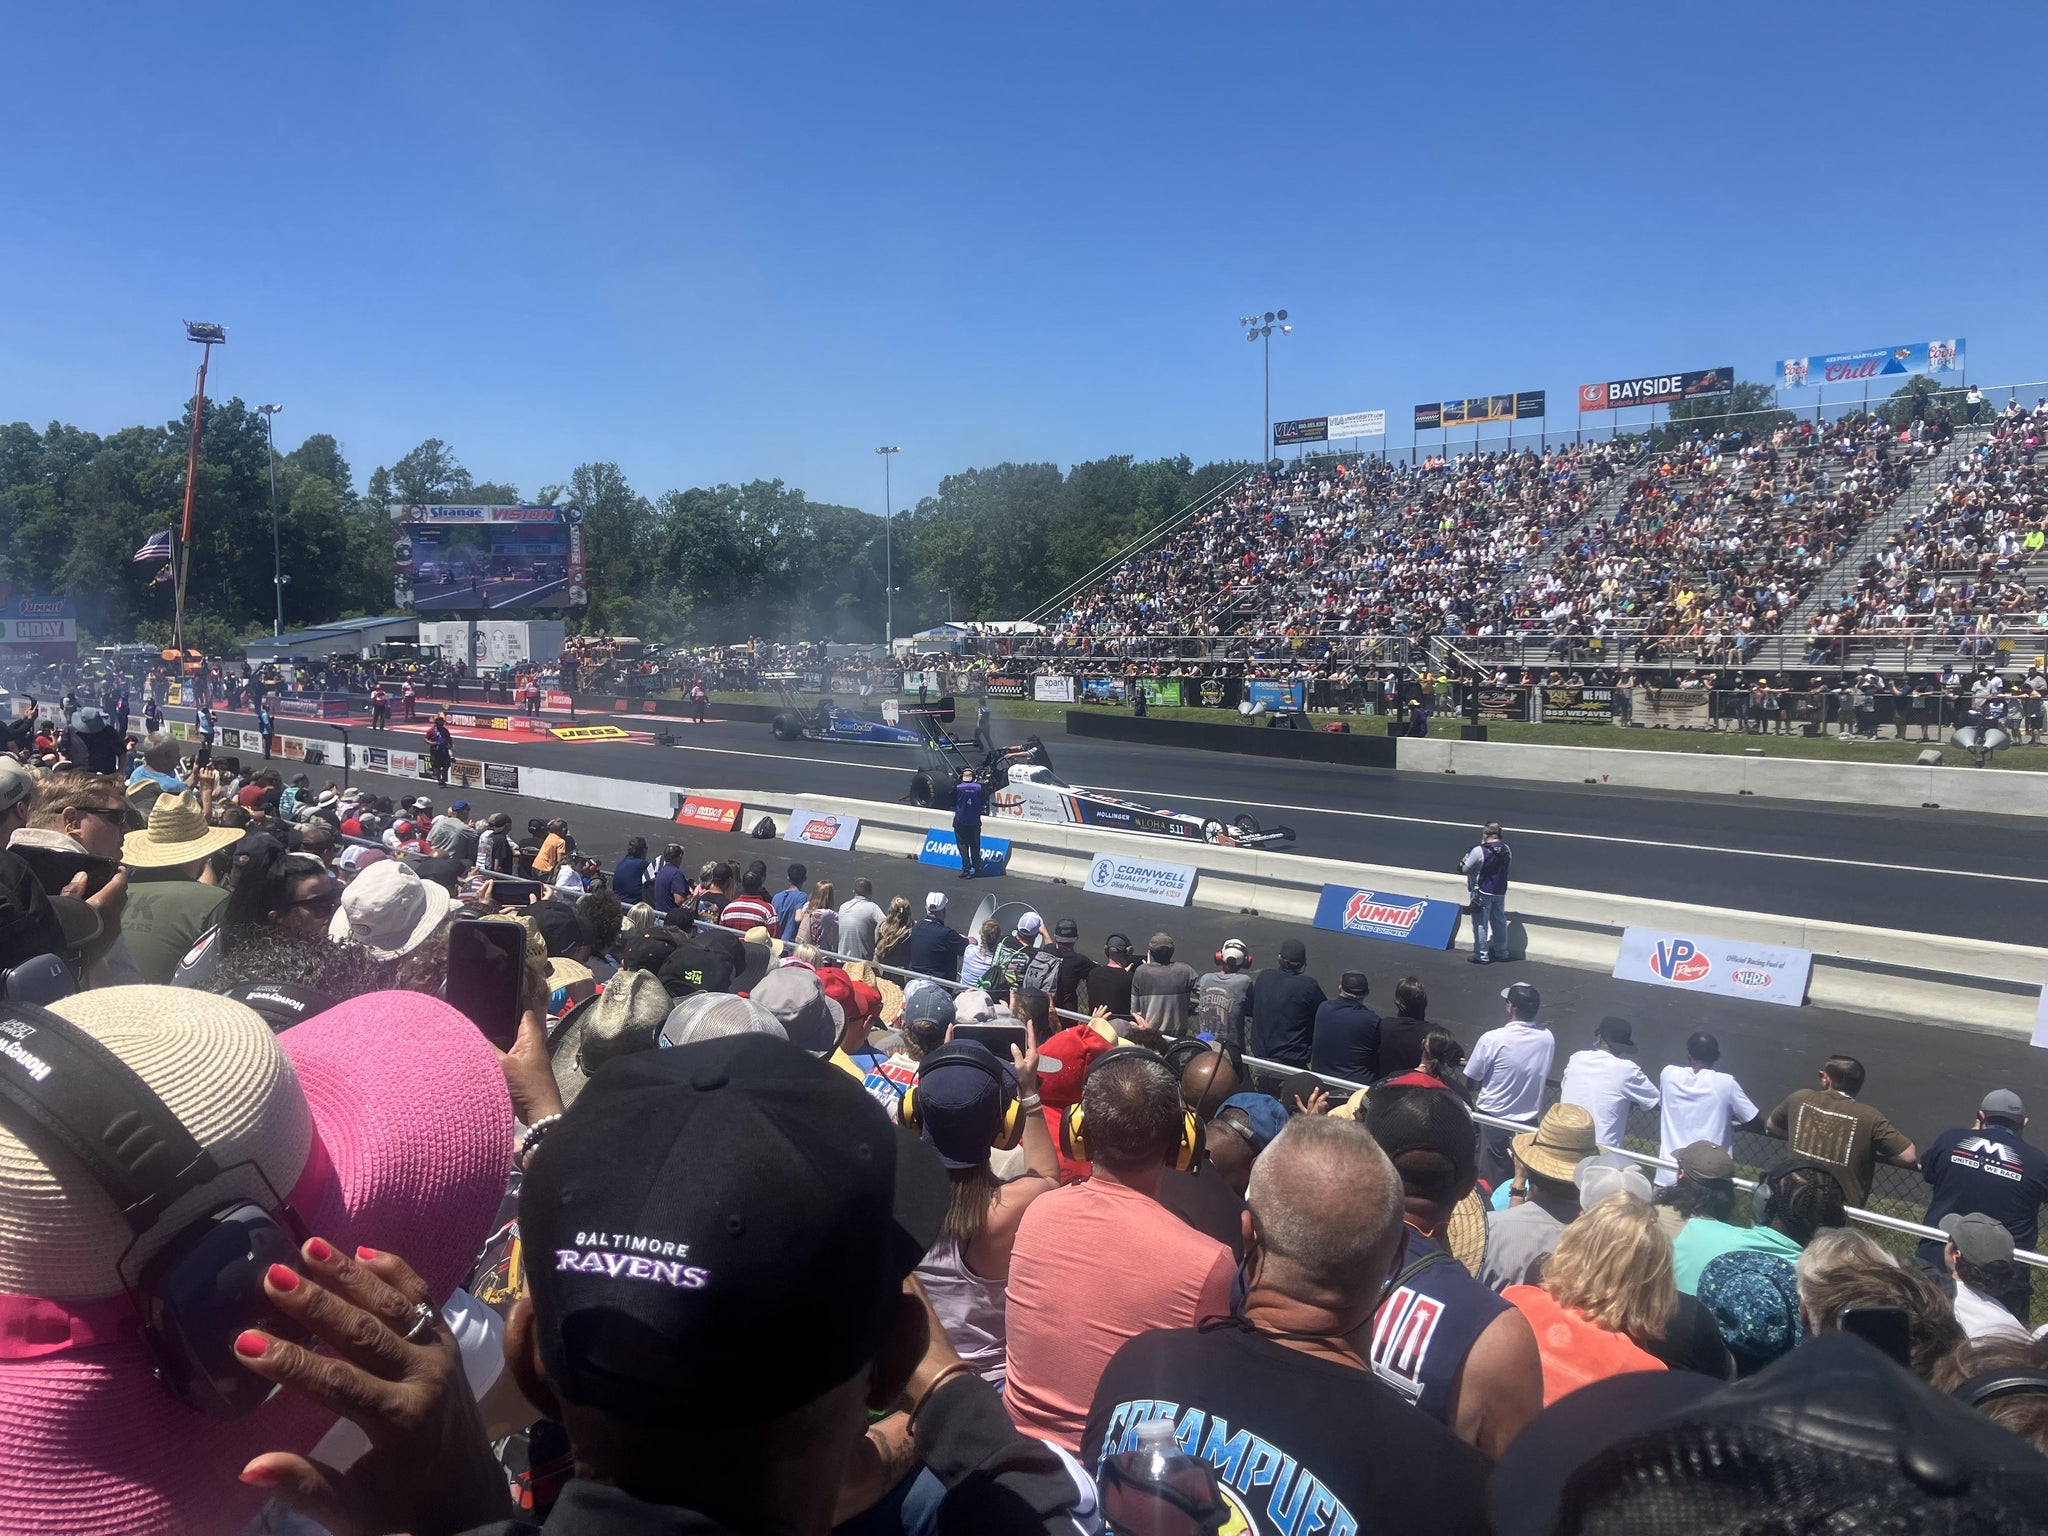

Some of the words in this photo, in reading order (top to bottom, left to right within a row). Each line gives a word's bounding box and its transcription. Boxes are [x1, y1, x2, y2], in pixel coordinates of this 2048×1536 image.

[1852, 351, 1887, 361] MARYLAND
[1825, 359, 1882, 382] Chill
[1609, 376, 1682, 400] BAYSIDE
[1274, 421, 1299, 437] VIA
[430, 506, 484, 518] Strange
[491, 507, 556, 521] VISION
[1044, 679, 1064, 689] spark
[1582, 690, 1594, 700] WE
[1594, 690, 1612, 700] PAVE
[560, 728, 619, 737] JEGS
[452, 764, 480, 777] FARMER
[966, 798, 972, 806] 4
[995, 792, 1024, 816] MS
[1096, 811, 1130, 820] HOLLINGER
[1169, 823, 1185, 835] 5.11
[925, 840, 964, 858] CAMPIN
[979, 847, 1004, 863] ORLD
[1117, 865, 1185, 882] CORNWELL
[1110, 881, 1125, 889] Official
[1125, 883, 1149, 893] Professional
[1149, 886, 1159, 894] Tools
[1114, 873, 1150, 884] QUALITY
[1155, 879, 1185, 890] TOOLS
[1350, 923, 1372, 933] RACING
[1373, 926, 1410, 937] EQUIPMENT
[1656, 939, 1695, 980] VP
[1725, 954, 1745, 964] Official
[1747, 957, 1766, 968] Racing
[1766, 960, 1778, 968] Fuel
[1778, 961, 1786, 969] of
[1676, 964, 1710, 977] Racing
[1737, 971, 1767, 985] NHRA
[246, 992, 305, 1012] Honeywell
[1952, 1155, 1979, 1168] UNITED
[1986, 1165, 1998, 1175] WE
[1999, 1168, 2022, 1181] RACE
[574, 1231, 690, 1259] BALTIMORE
[554, 1249, 712, 1289] RAVENS
